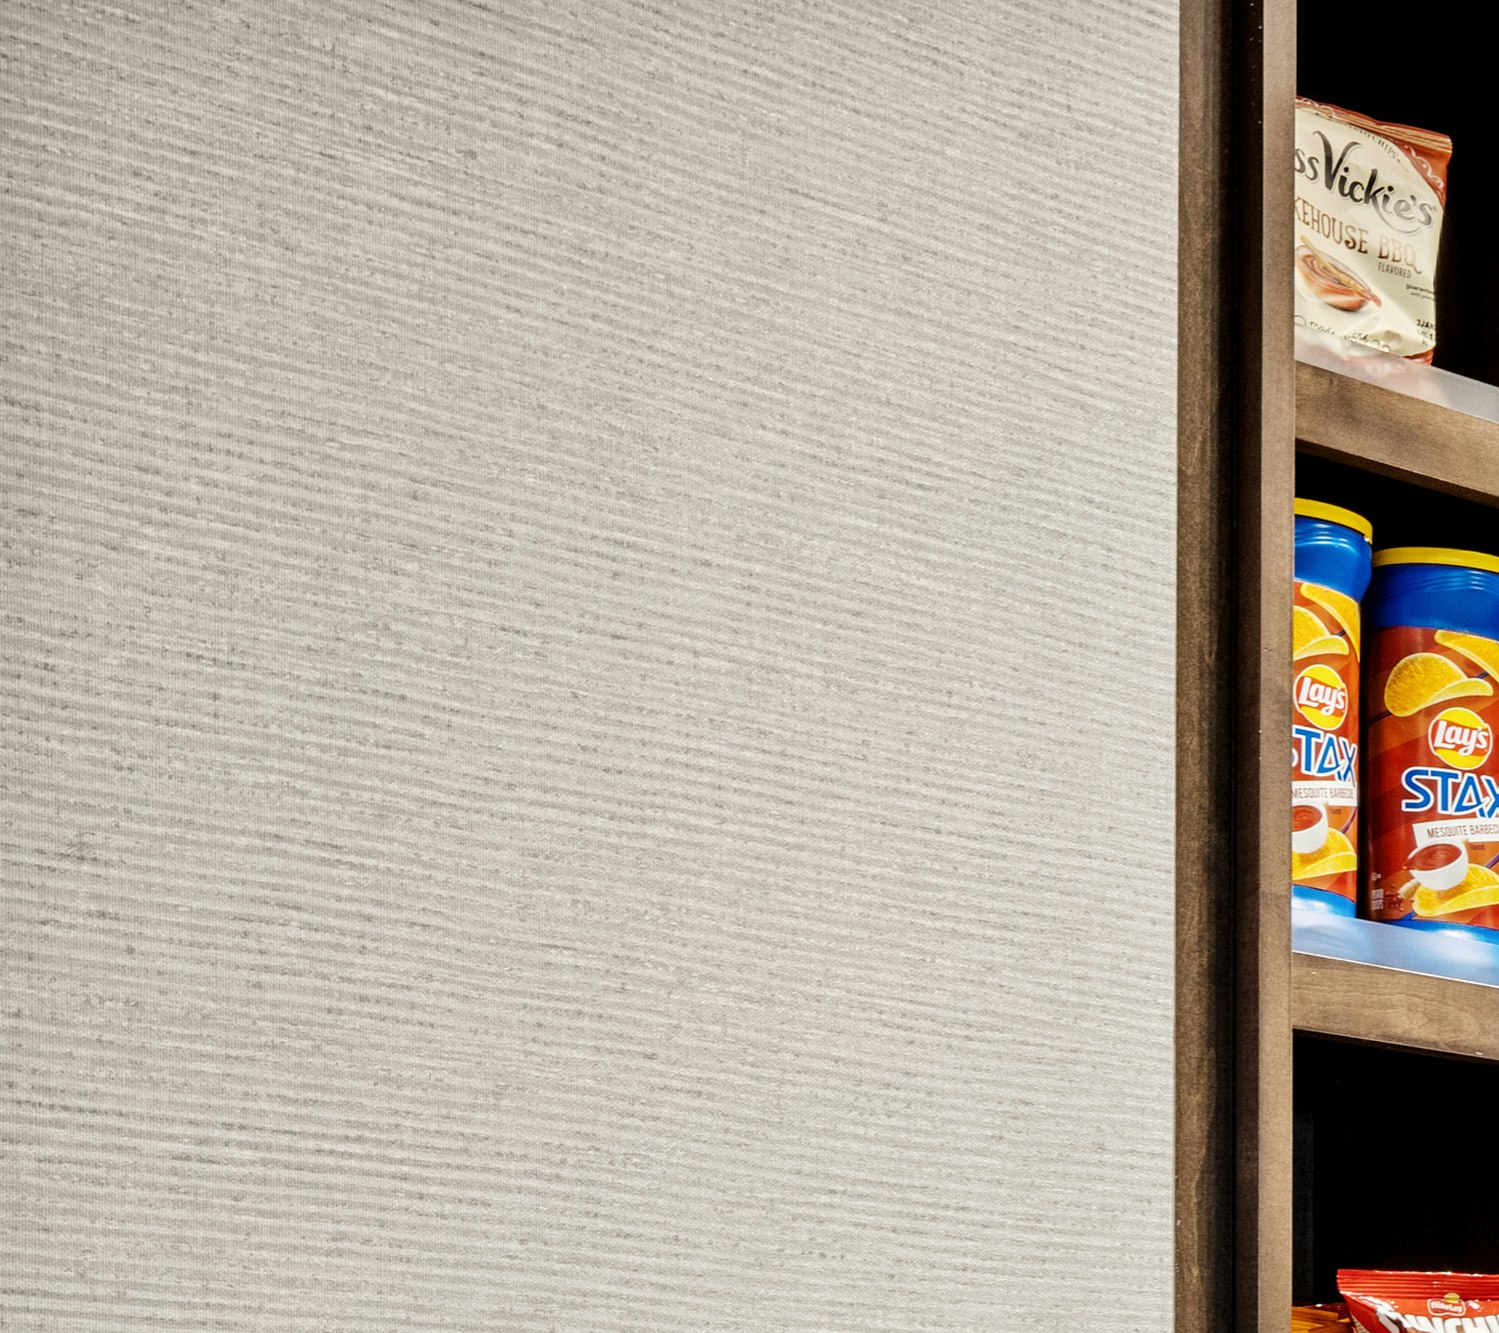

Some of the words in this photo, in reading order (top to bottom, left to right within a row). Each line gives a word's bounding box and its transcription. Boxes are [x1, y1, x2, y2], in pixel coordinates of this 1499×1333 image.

[1378, 234, 1422, 275] BBQ
[1378, 262, 1412, 279] FLAVORED
[1434, 719, 1488, 758] Lay's
[1426, 824, 1467, 838] MESQUITE
